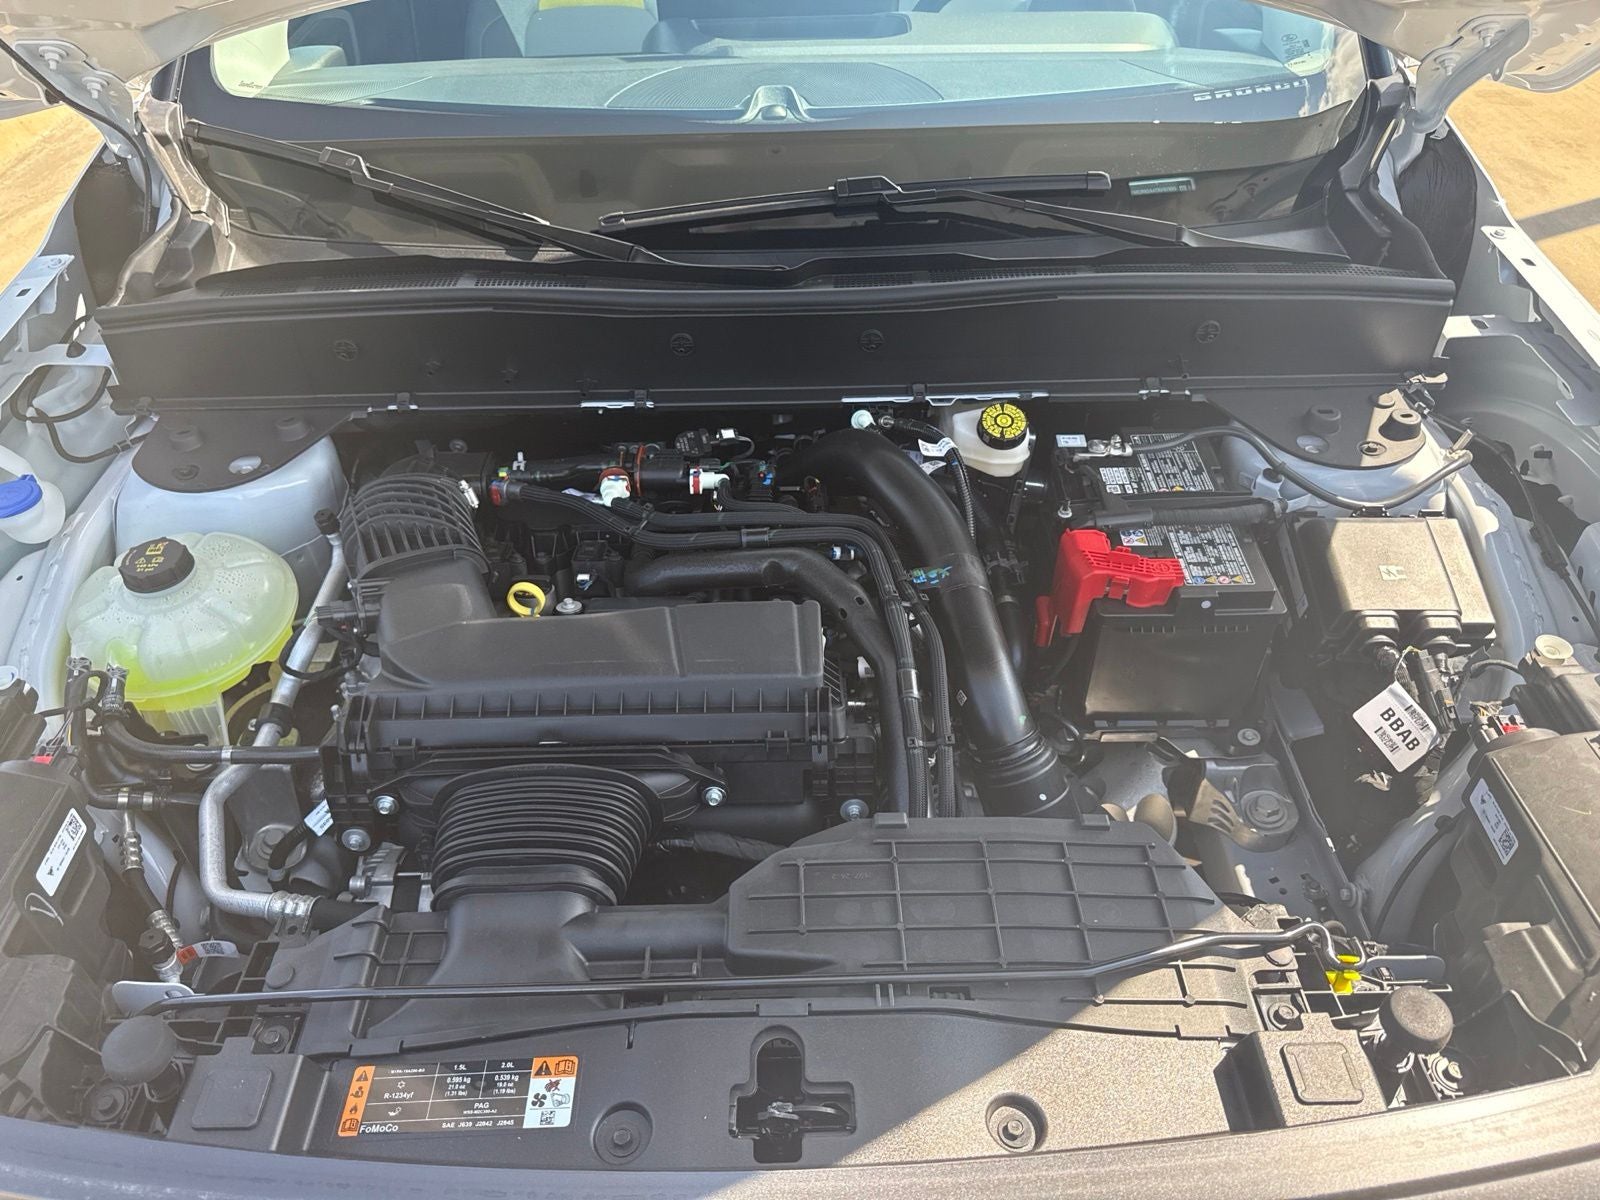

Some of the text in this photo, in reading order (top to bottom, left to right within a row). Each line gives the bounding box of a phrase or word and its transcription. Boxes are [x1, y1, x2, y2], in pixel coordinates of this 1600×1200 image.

[1379, 707, 1421, 751] BBAB
[454, 1063, 467, 1071] 1.5L
[501, 1061, 515, 1069] 2.0L
[463, 1075, 471, 1084] kg
[511, 1074, 519, 1083] kg
[383, 1091, 414, 1099] R-1234yf
[474, 1102, 490, 1110] PAG
[442, 1120, 456, 1128] SAE
[458, 1120, 473, 1128] J639
[360, 1123, 399, 1134] FoMoCo
